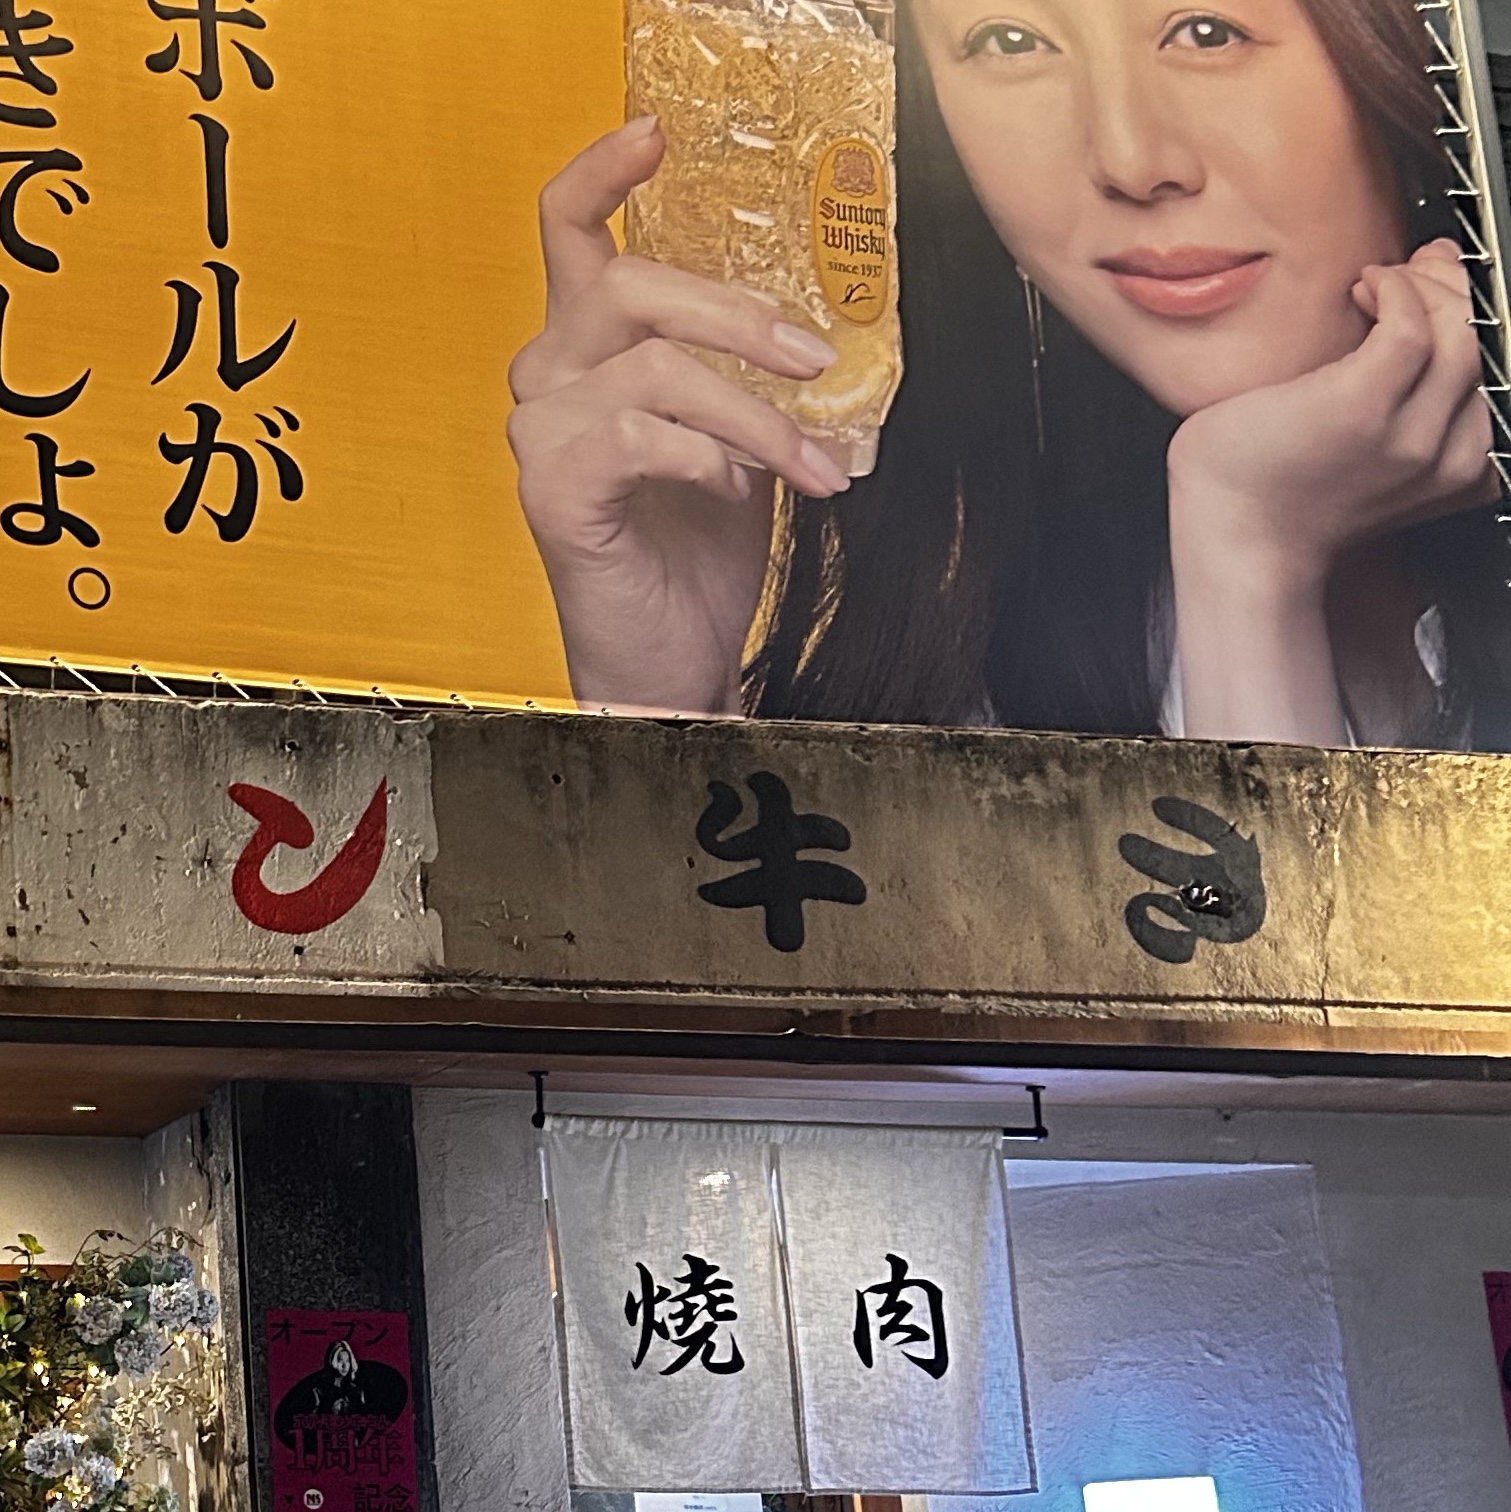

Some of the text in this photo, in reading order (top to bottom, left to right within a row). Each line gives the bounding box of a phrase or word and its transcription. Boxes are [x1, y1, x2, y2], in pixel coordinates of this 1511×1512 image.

[819, 196, 886, 231] Suntory
[821, 224, 886, 261] Whisky
[270, 1317, 391, 1347] オープン
